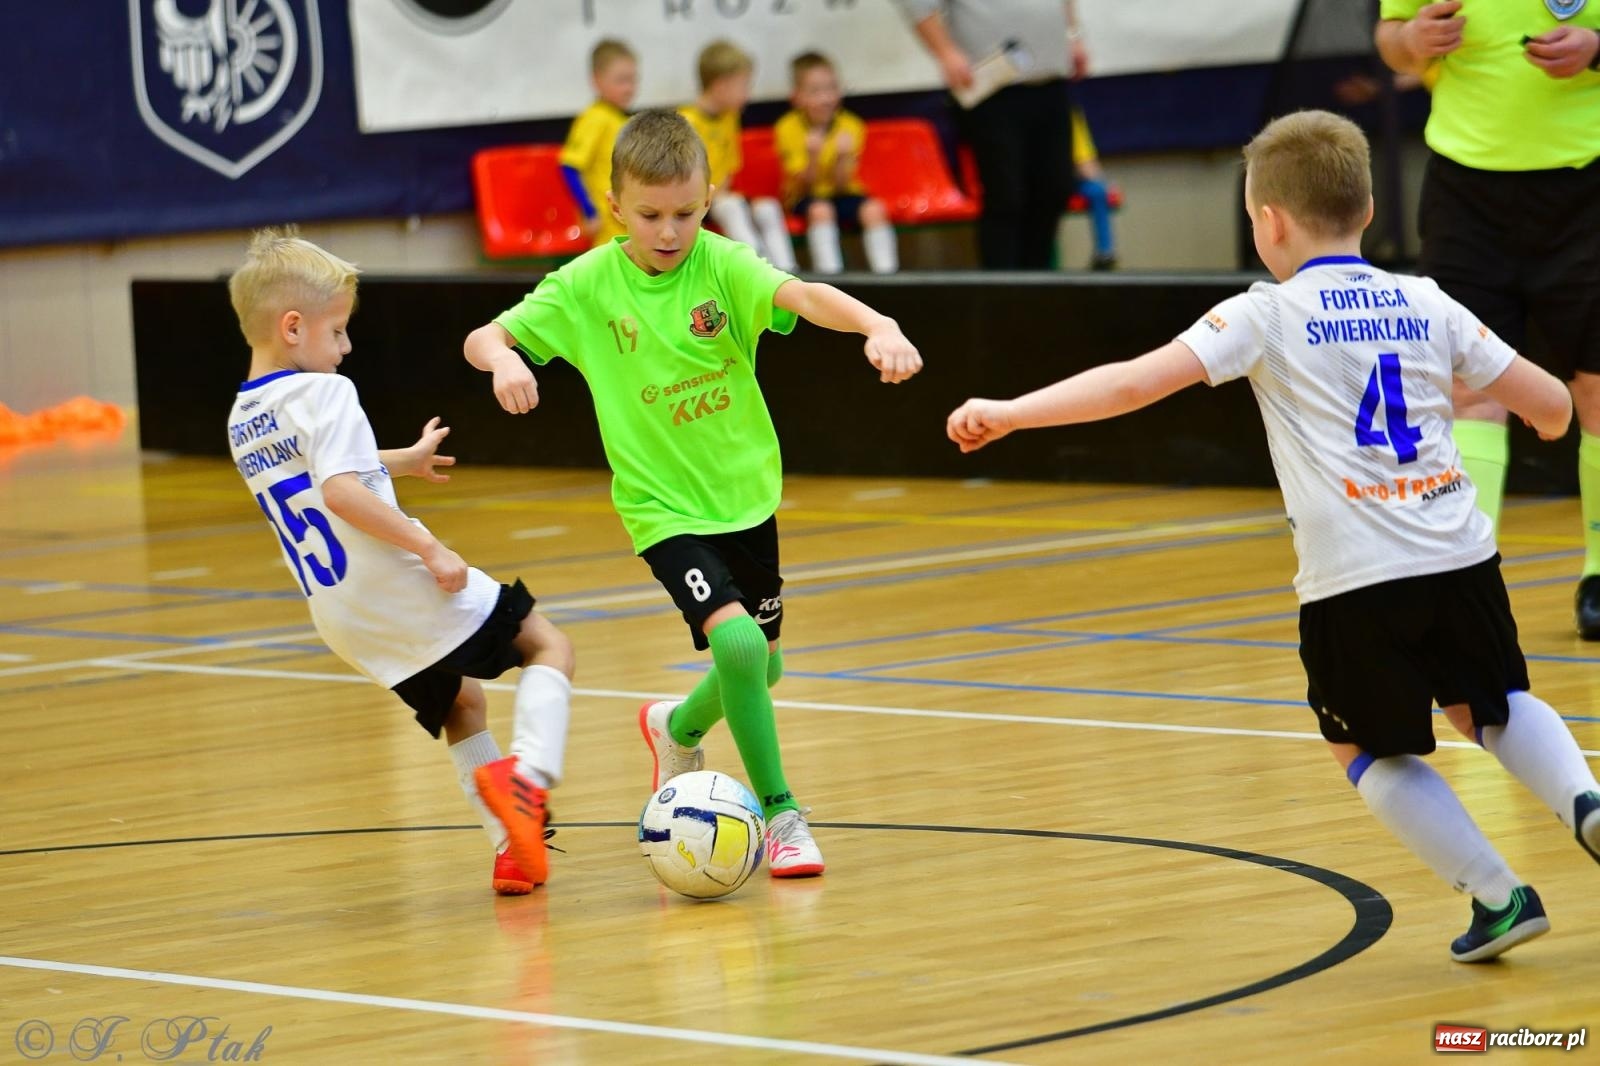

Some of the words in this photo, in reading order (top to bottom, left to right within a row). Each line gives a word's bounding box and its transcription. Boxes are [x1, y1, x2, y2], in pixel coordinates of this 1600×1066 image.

[1319, 287, 1409, 311] FORTECA
[607, 315, 638, 355] 19
[1306, 316, 1431, 346] ŚWIERKLANY
[668, 385, 731, 426] KKS
[1354, 353, 1424, 465] 4
[684, 567, 712, 603] 8
